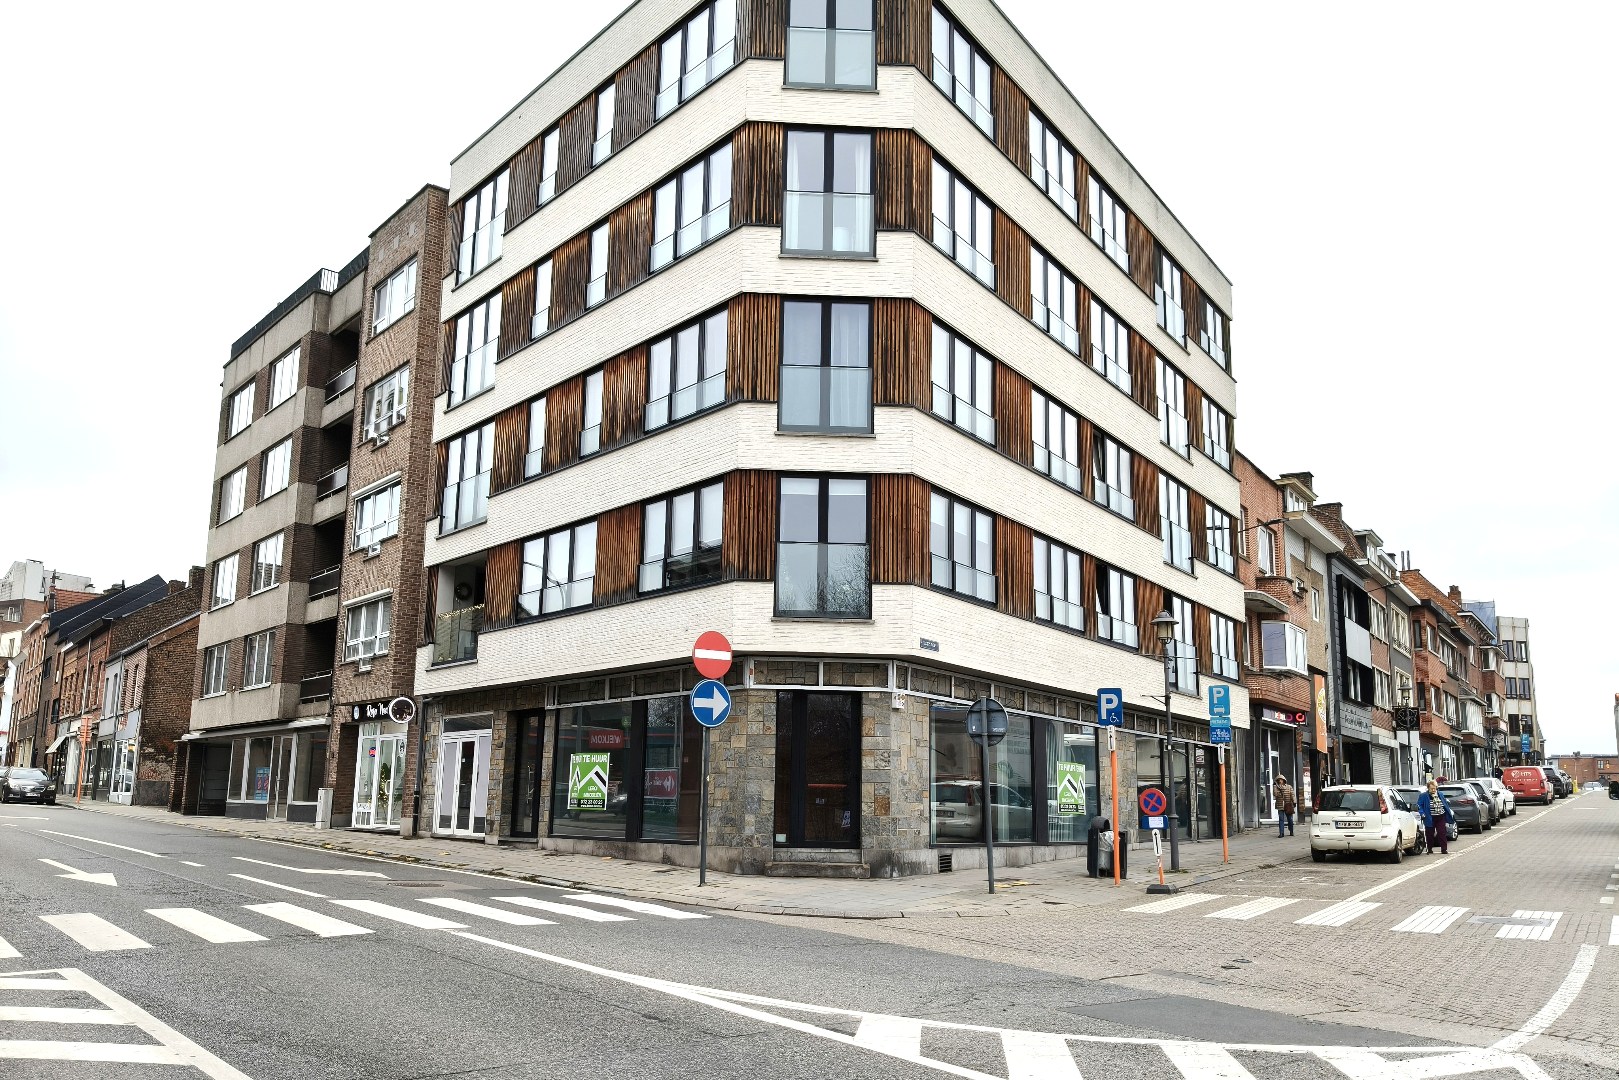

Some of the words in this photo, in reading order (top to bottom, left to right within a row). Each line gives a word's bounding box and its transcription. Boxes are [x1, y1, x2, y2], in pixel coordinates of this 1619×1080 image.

[1212, 687, 1224, 704] P
[1100, 693, 1118, 720] P
[583, 755, 590, 763] TE
[591, 755, 608, 763] HUUR
